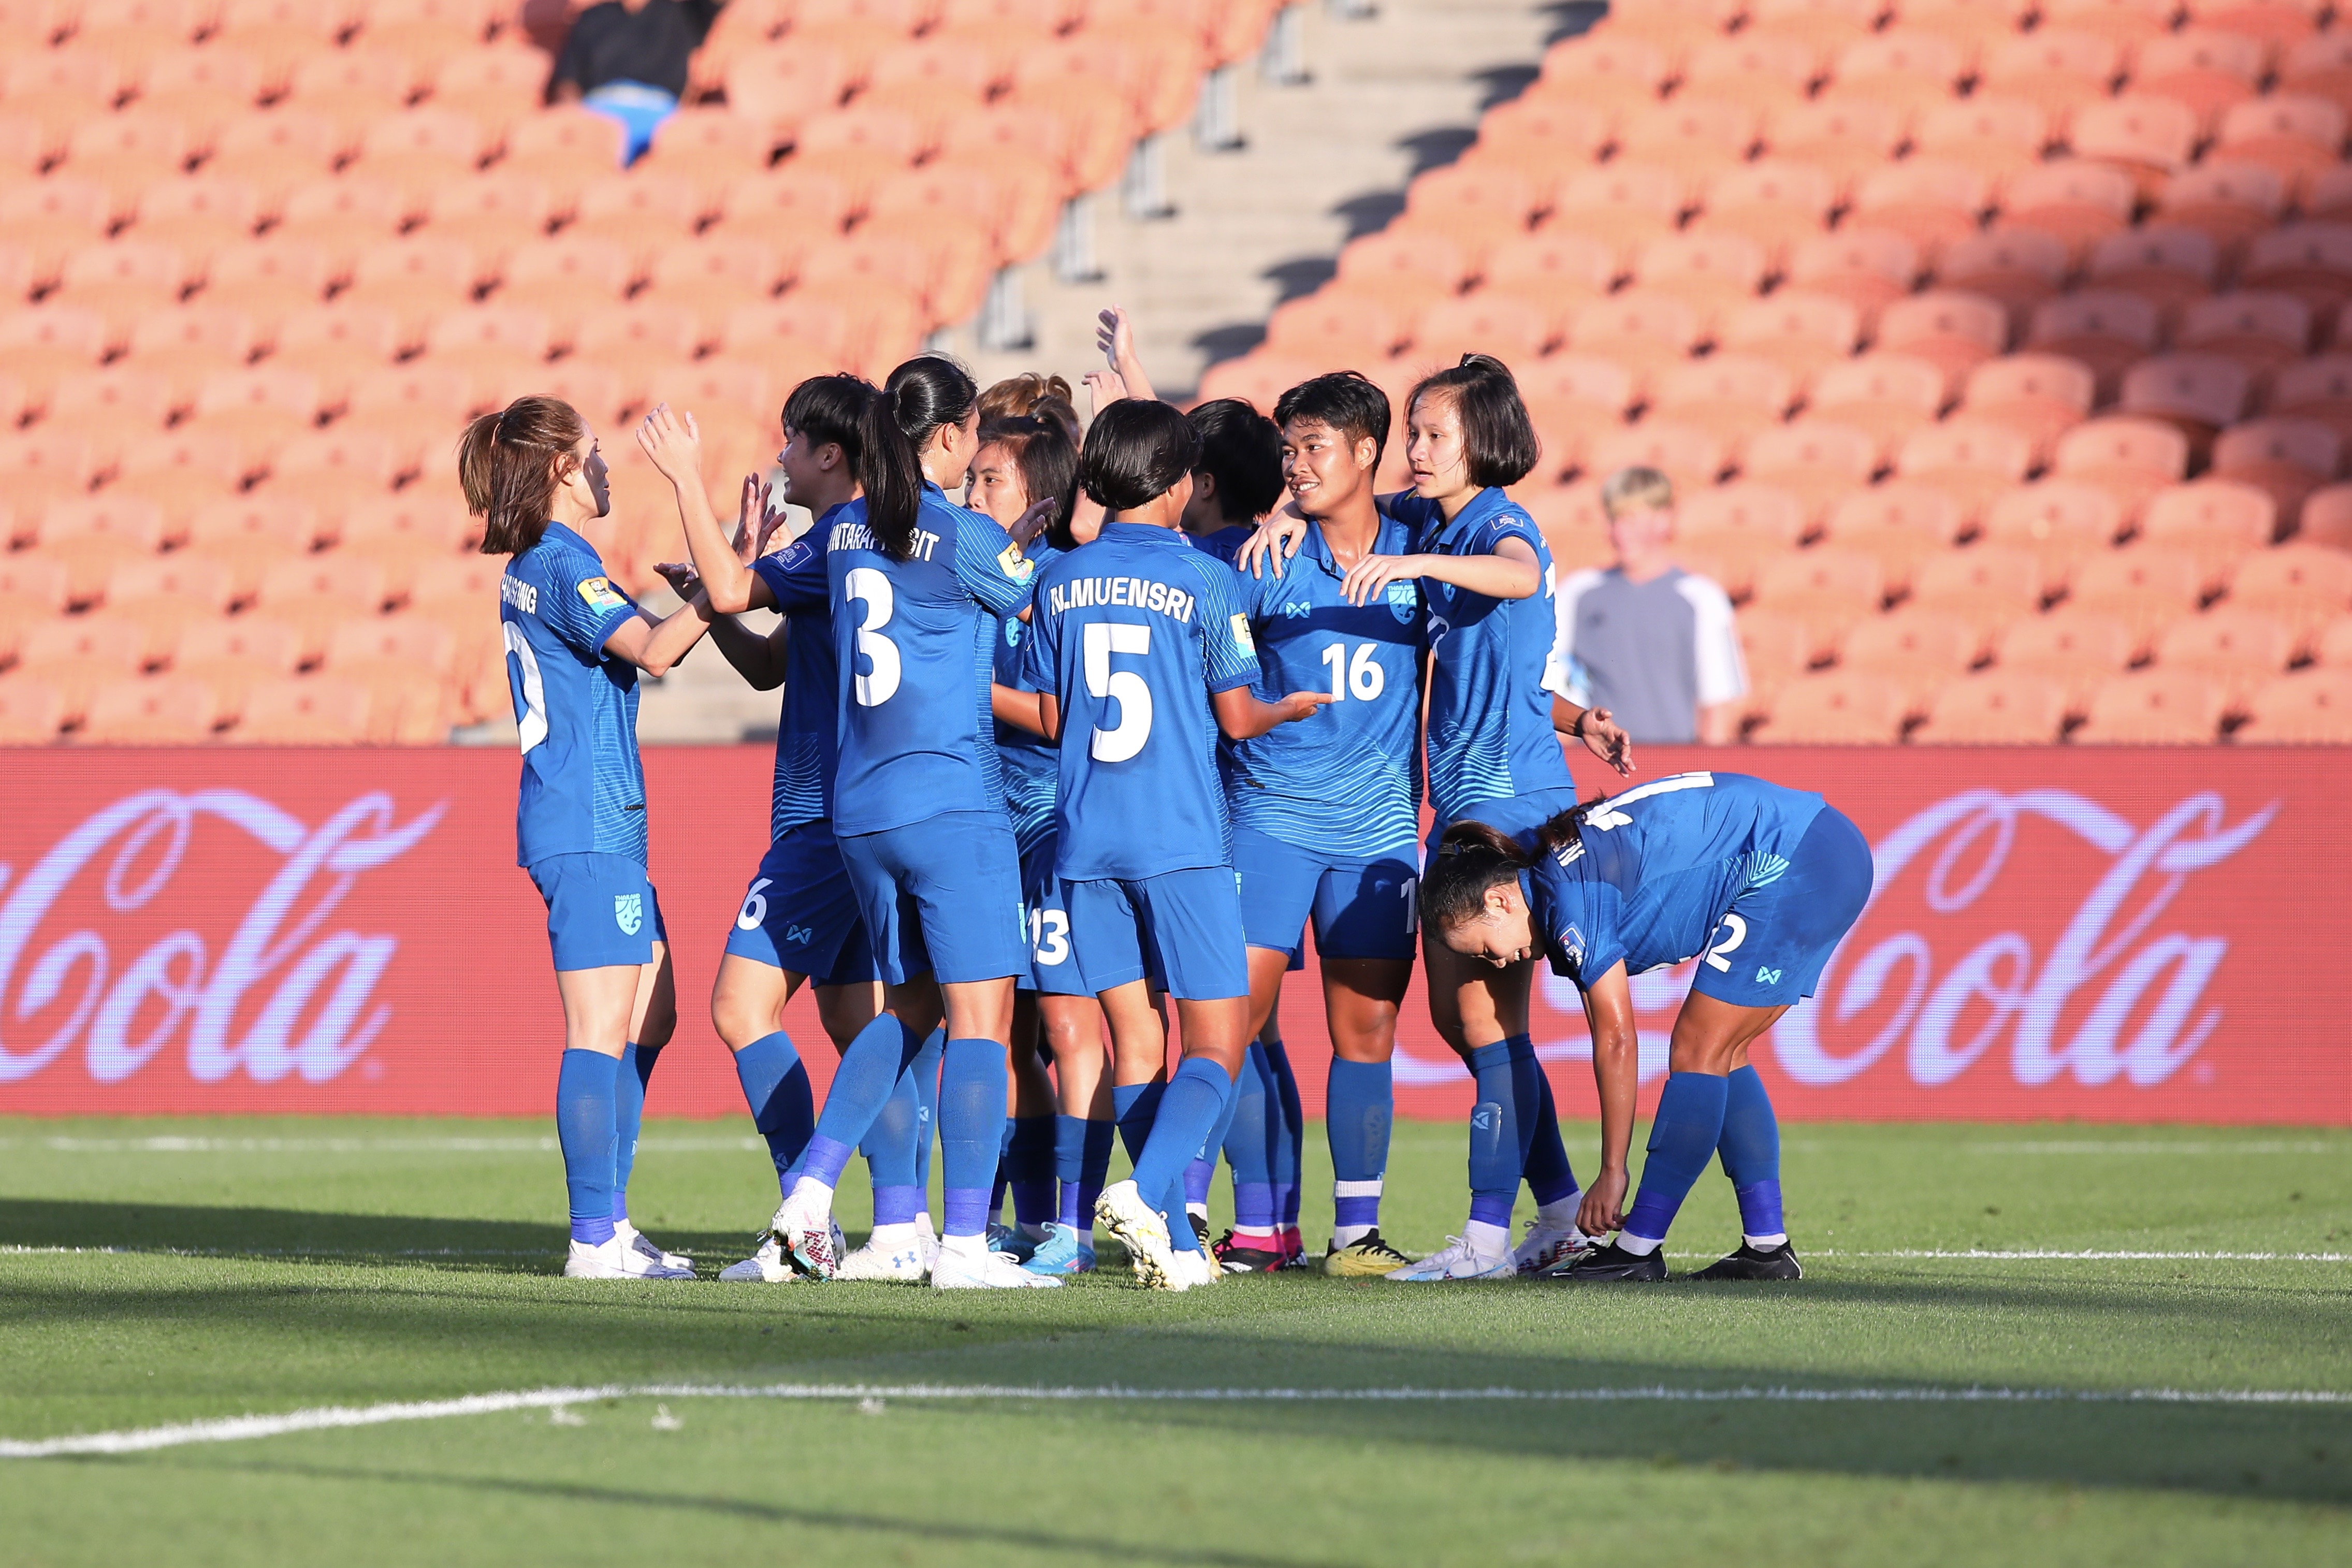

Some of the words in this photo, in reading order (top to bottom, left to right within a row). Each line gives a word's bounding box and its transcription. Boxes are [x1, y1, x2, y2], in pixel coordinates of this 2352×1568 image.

[1050, 577, 1195, 623] N.MUENSRI
[845, 568, 901, 707] 3
[1083, 623, 1152, 762] 5
[1322, 643, 1385, 701] 16
[614, 893, 641, 902] THAILAND
[737, 877, 773, 931] 6
[1401, 877, 1418, 934] 1
[1027, 908, 1070, 966] 13
[1702, 913, 1748, 974] 2
